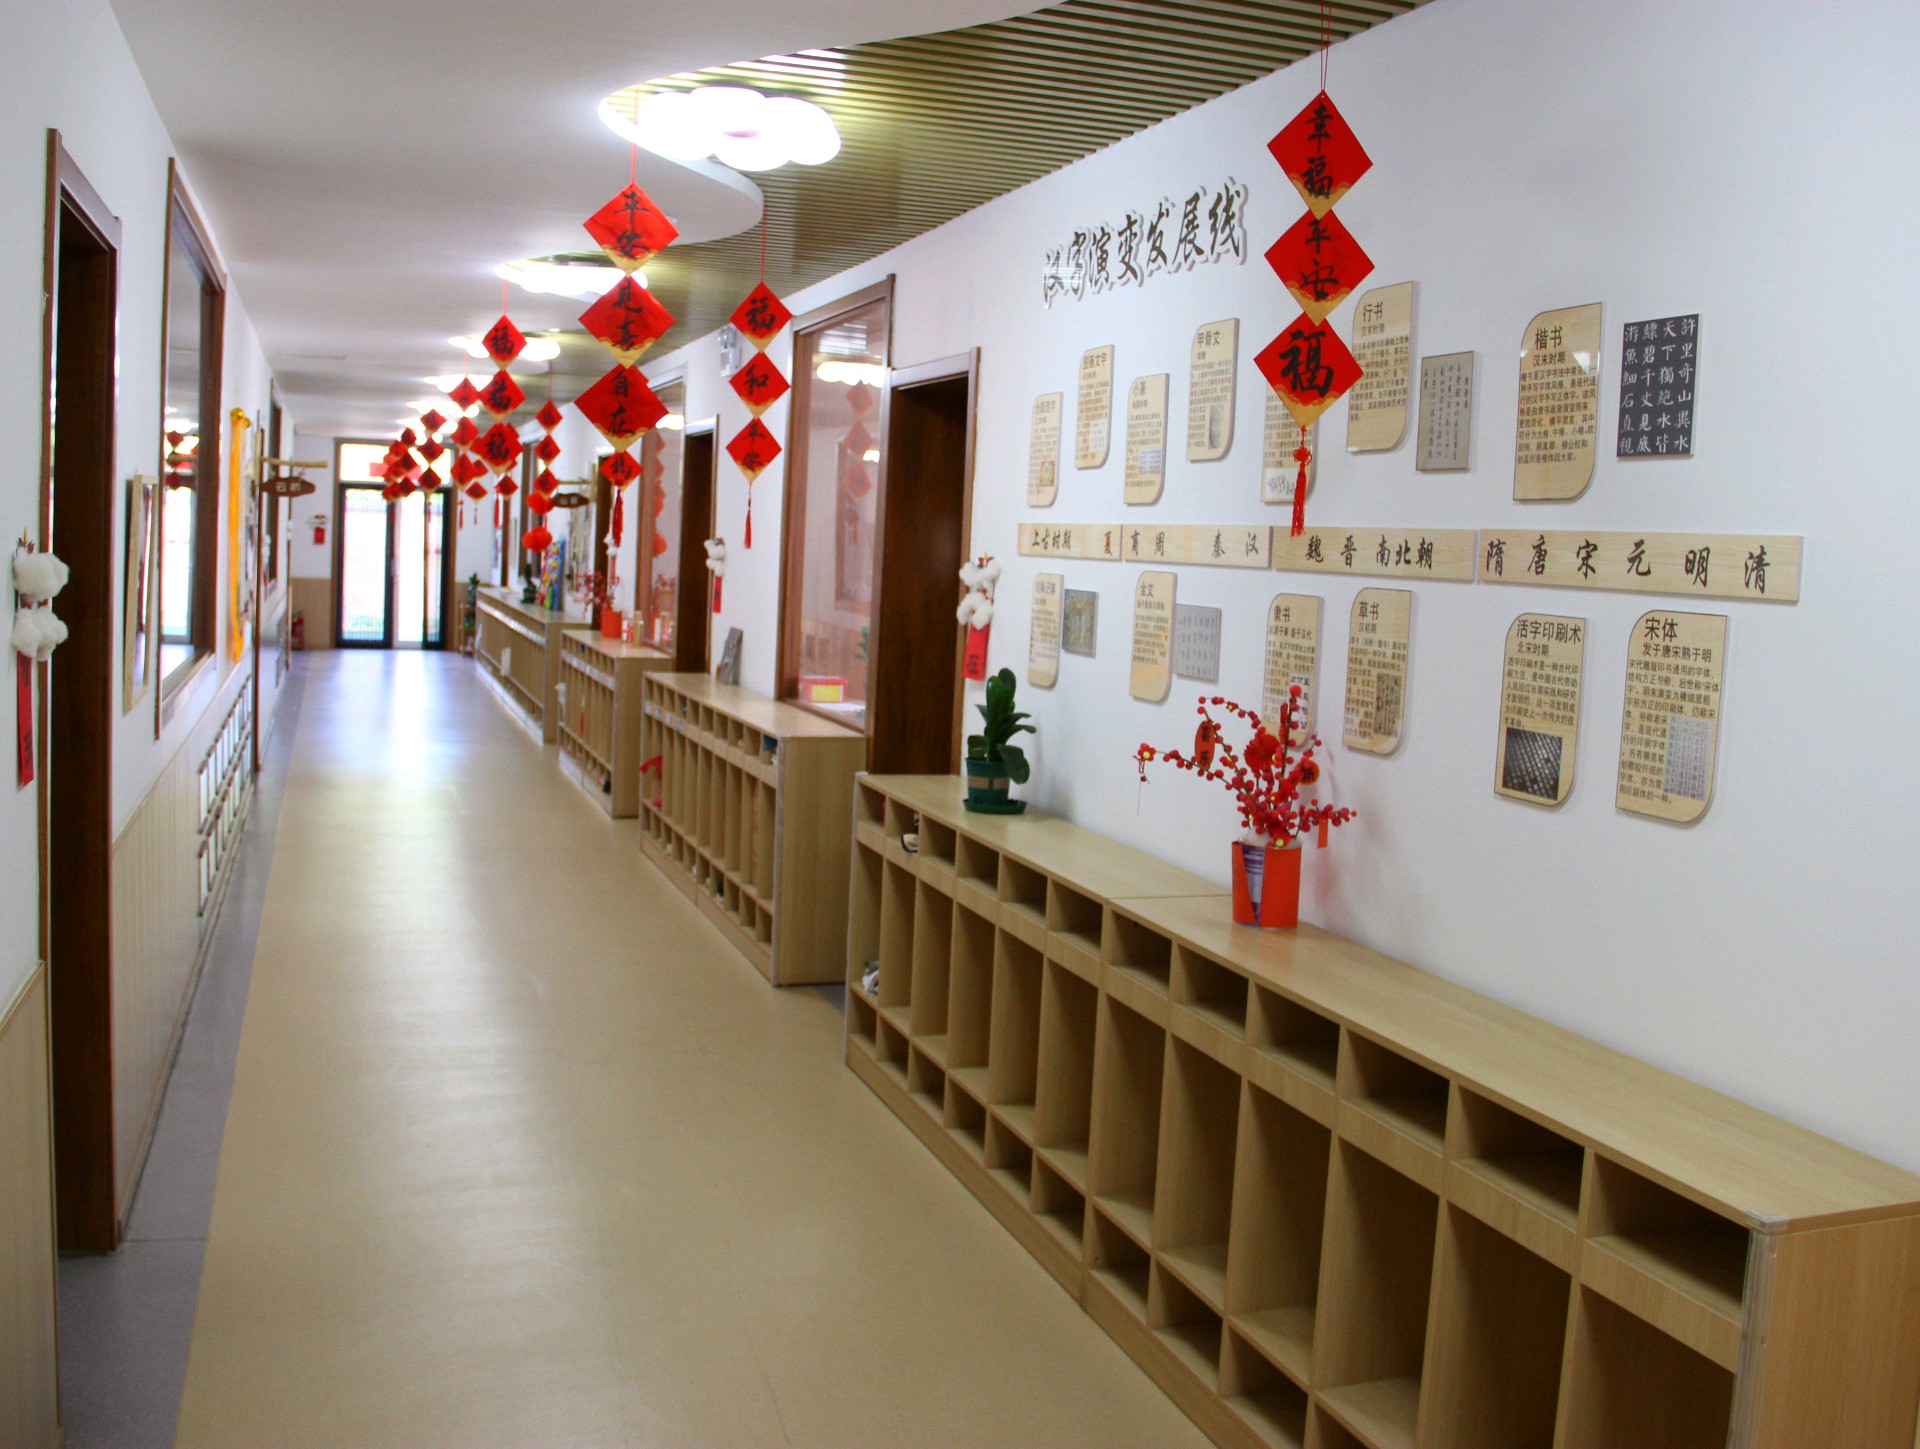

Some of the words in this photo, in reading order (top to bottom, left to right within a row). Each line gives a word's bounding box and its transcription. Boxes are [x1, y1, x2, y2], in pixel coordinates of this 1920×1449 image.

[1302, 101, 1334, 199] 幸福
[611, 192, 650, 260] 平安
[1043, 183, 1240, 303] 汉字演变发展线
[1300, 219, 1339, 302] 平安
[745, 297, 776, 332] 福
[1362, 301, 1383, 323] 行书
[1197, 331, 1221, 348] 甲骨文
[1534, 325, 1563, 350] 楷书
[1279, 329, 1334, 397] 福
[1532, 352, 1566, 368] 汉末时期
[1031, 528, 1071, 550] 上古时期
[1103, 531, 1113, 555] 夏
[1154, 531, 1165, 557] 周
[1211, 530, 1225, 558] 秦
[1245, 532, 1259, 557] 汉
[1305, 534, 1324, 564] 魏
[1341, 534, 1357, 569] 晋
[1376, 533, 1434, 570] 南北朝
[1486, 539, 1506, 577] 隋
[1527, 534, 1548, 576] 唐
[1576, 538, 1598, 579] 宋
[1626, 538, 1652, 577] 元
[1684, 547, 1711, 588] 明
[1744, 545, 1771, 595] 清
[1140, 582, 1154, 598] 金文
[1273, 603, 1291, 623] 隶书
[1358, 600, 1379, 621] 草书
[1516, 618, 1582, 644] 活字印刷术
[1644, 617, 1679, 643] 宋体
[1517, 641, 1550, 657] 北宋时期
[1642, 641, 1712, 664] 发于唐宋熟于明
